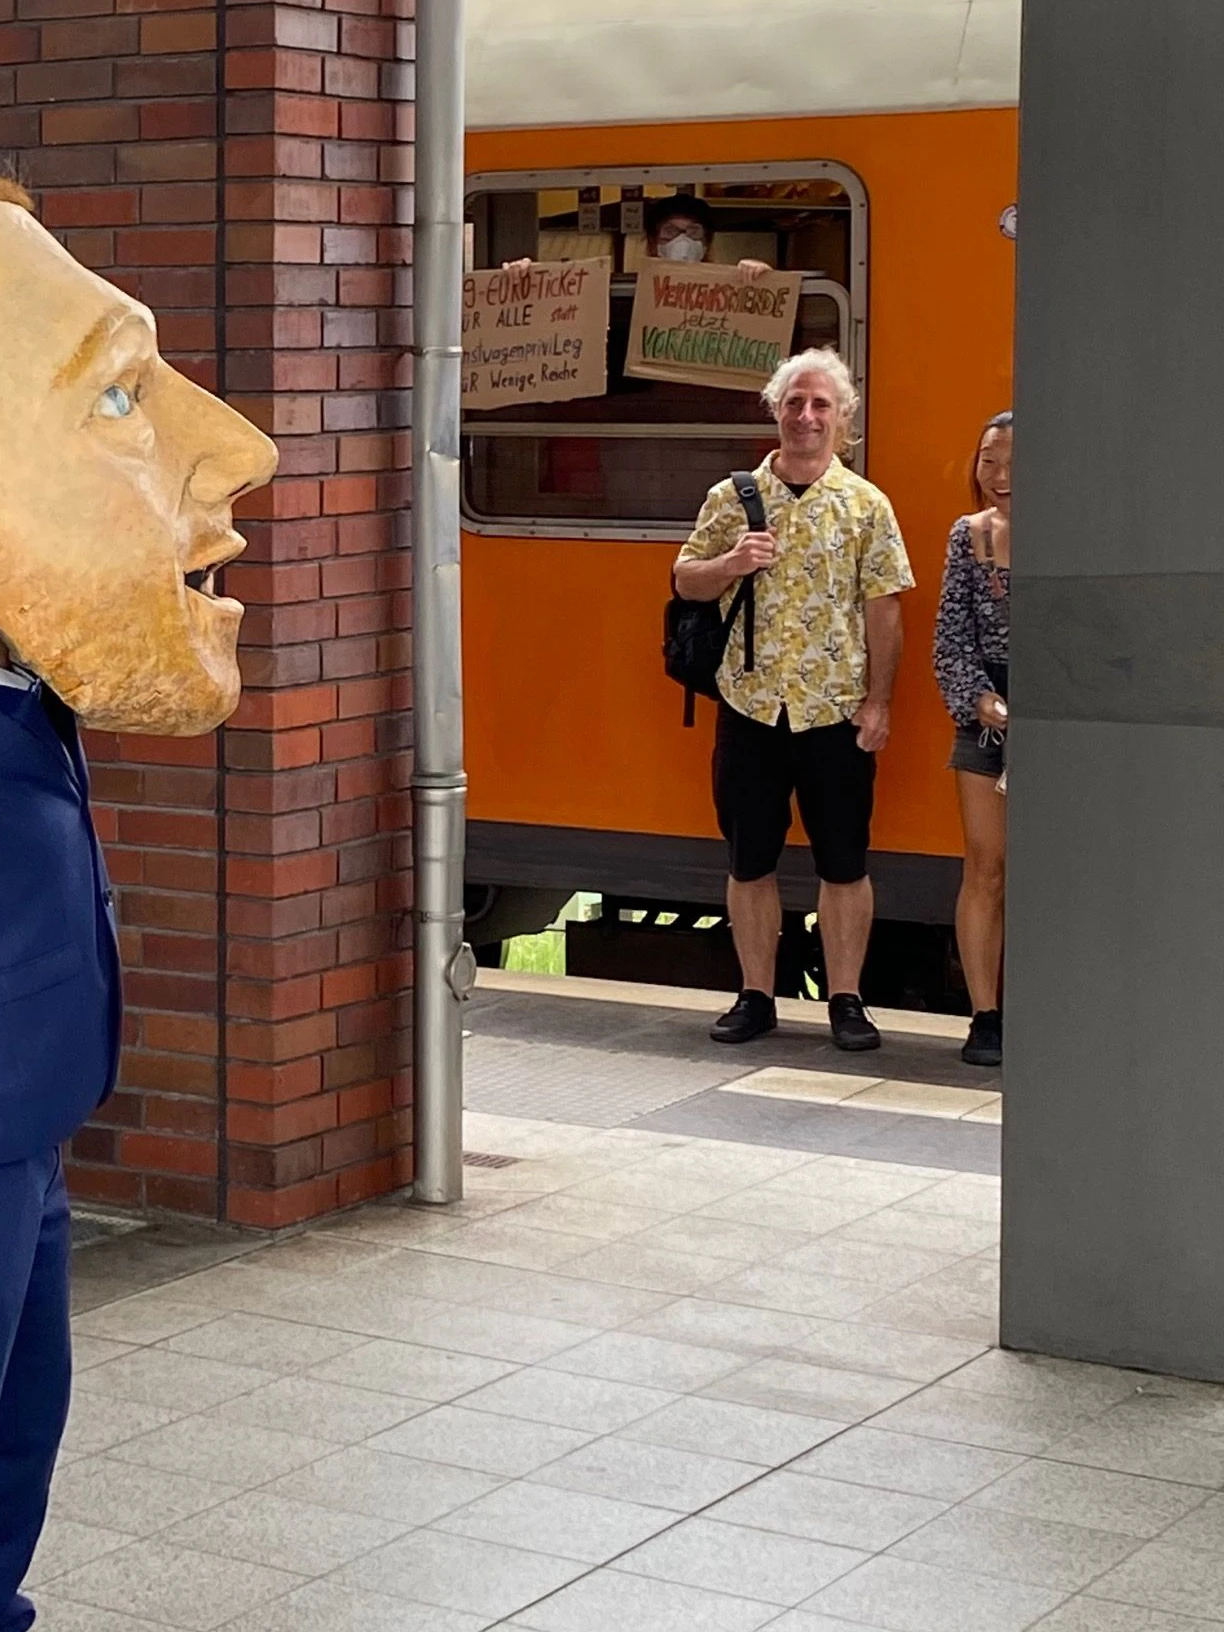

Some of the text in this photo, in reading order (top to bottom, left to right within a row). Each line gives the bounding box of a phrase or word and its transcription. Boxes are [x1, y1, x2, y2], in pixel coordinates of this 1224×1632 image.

[496, 304, 533, 328] ALLE
[550, 305, 578, 323] statt
[678, 311, 729, 330] jetzt
